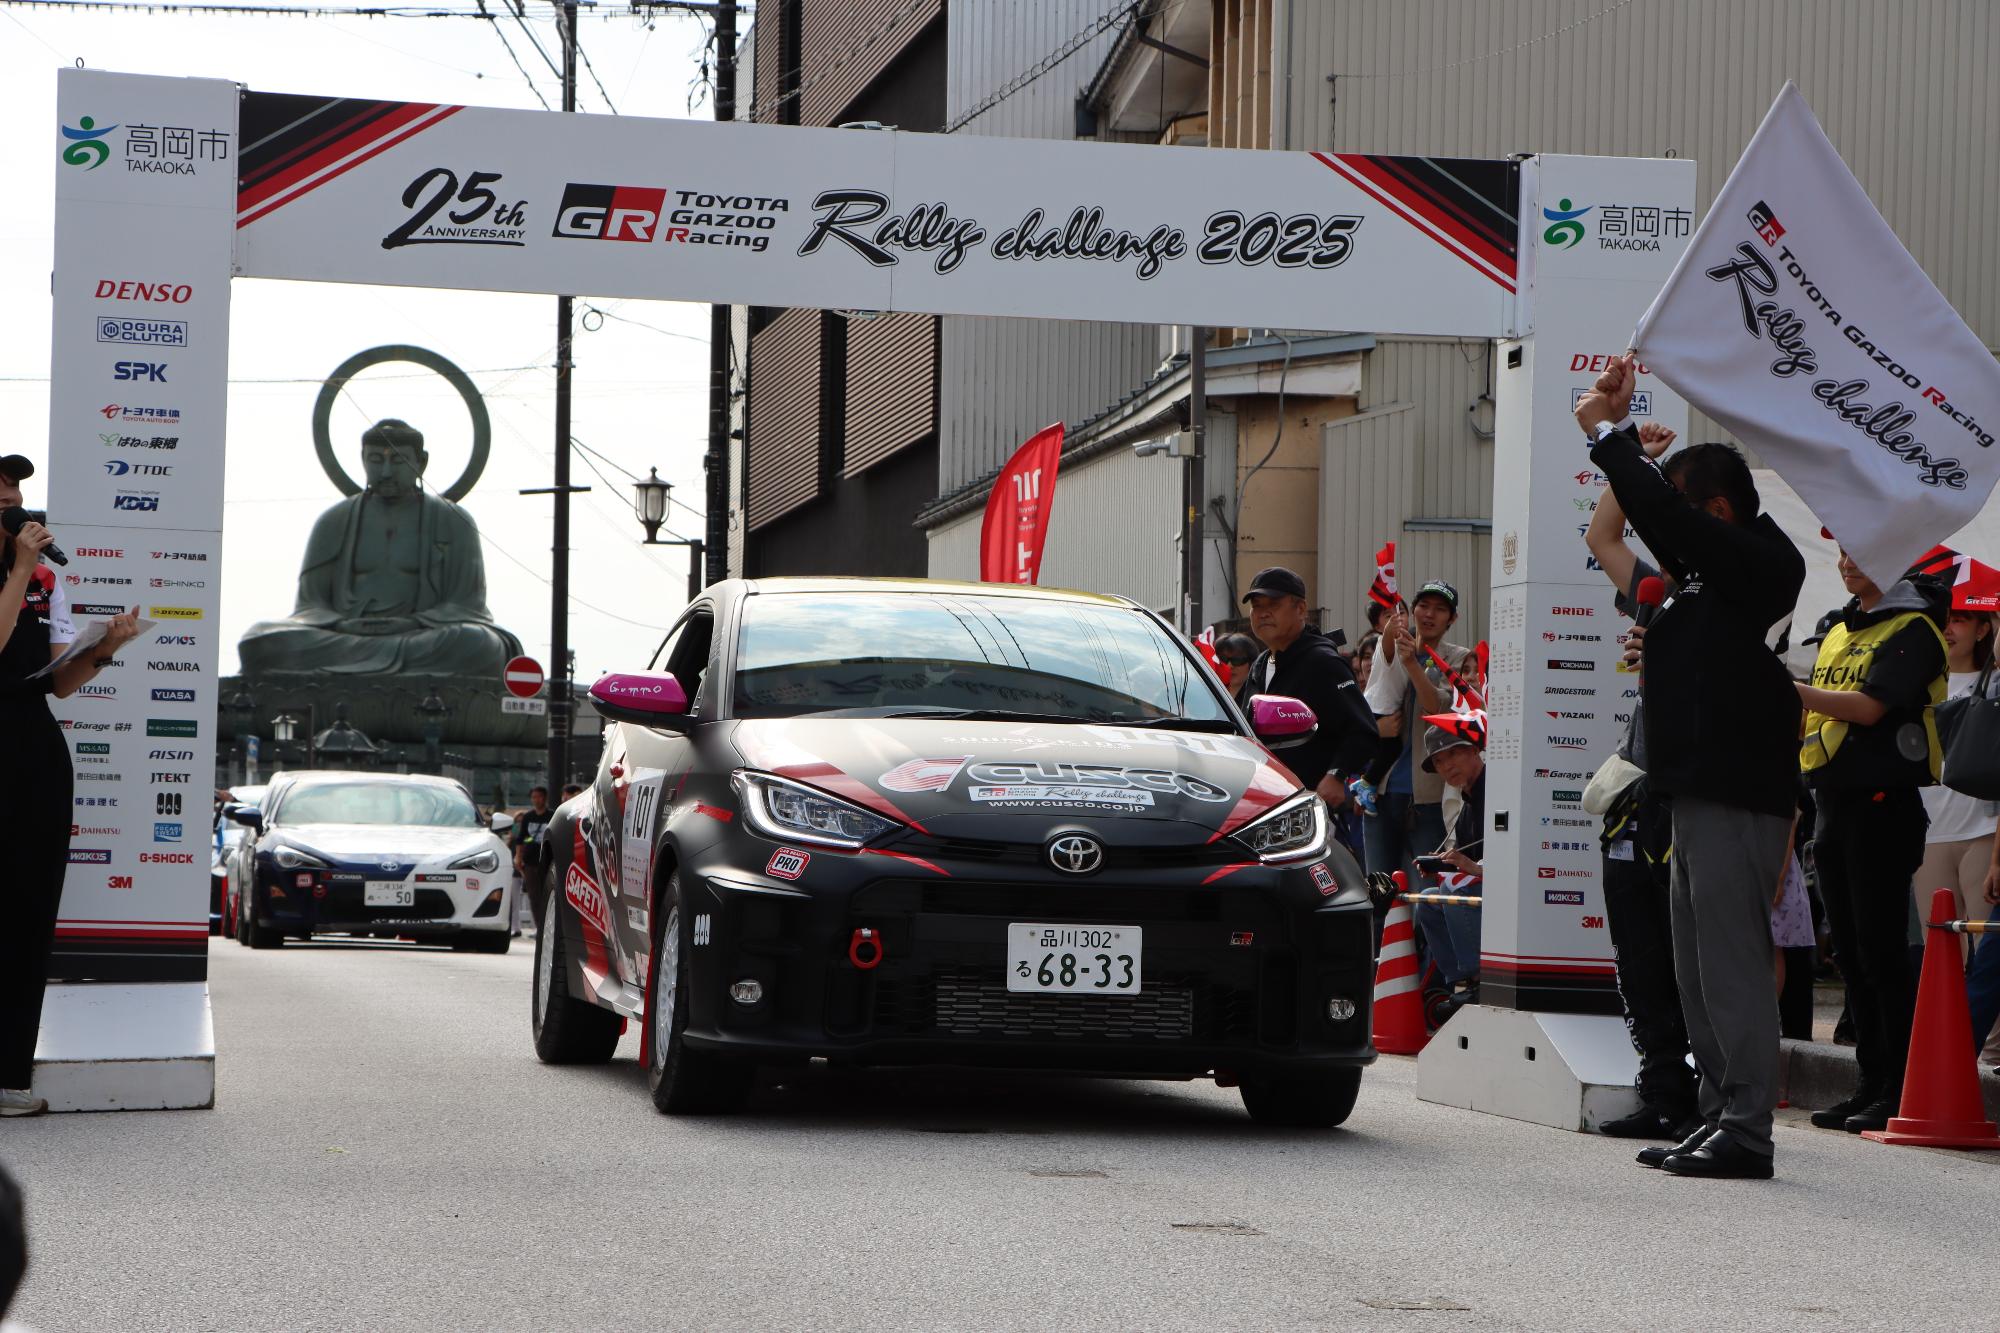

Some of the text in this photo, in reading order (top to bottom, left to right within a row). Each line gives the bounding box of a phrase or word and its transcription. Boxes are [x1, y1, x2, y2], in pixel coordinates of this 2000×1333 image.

[125, 123, 230, 162] 高岡市
[125, 159, 196, 176] TAKAOKA
[674, 190, 789, 212] TOYOTA
[556, 206, 656, 242] GR
[669, 209, 776, 231] GAZOO
[1598, 204, 1693, 239] 高岡市
[422, 225, 526, 240] ANNIVERSARY
[797, 188, 1364, 281] Rally challenge 2025
[664, 228, 769, 252] Racing
[1598, 237, 1661, 252] TAKAOKA
[95, 279, 193, 304] DENSO
[122, 321, 183, 334] OGURA
[1748, 211, 1996, 449] GR TOYOTA GAZOO Racing
[122, 331, 183, 344] CLUTCH
[1706, 240, 1969, 490] Rally challenge
[114, 361, 169, 383] SPK
[122, 406, 180, 418] トヨタ車体
[131, 464, 176, 476] TTDC
[113, 495, 160, 512] KDDI
[76, 548, 124, 559] BRIDE
[83, 576, 133, 585] トヨタ東日本
[163, 579, 205, 588] SHINKO
[85, 606, 123, 614] YOKOHAMA
[160, 609, 200, 617] DUNLOP
[1552, 606, 1594, 617] BRIDE
[147, 661, 201, 672] NOMURA
[1559, 661, 1593, 670] YOKOHAMA
[155, 691, 192, 700] YUASA
[1544, 686, 1596, 696] BRIDGESTONE
[1560, 712, 1594, 720] YAZAKI
[73, 722, 111, 732] Garage
[1547, 735, 1587, 746] MIZUHO
[149, 751, 194, 761] AISIN
[150, 772, 191, 784] JTEKT
[1549, 770, 1582, 780] Garage
[1044, 786, 1147, 802] Rally challenge
[75, 797, 118, 807] 東海理化
[988, 800, 1145, 813] www.cusco.co.jp
[631, 784, 656, 839] 101
[81, 827, 121, 835] DAIHATSU
[139, 852, 193, 864] G-SHOCK
[775, 856, 799, 871] PRO
[1316, 871, 1334, 885] PRO
[1557, 870, 1592, 878] DAIHATSU
[108, 876, 133, 889] 3M
[568, 870, 603, 918] SAFETY
[1581, 916, 1604, 929] 3M
[1037, 953, 1134, 988] 68-33
